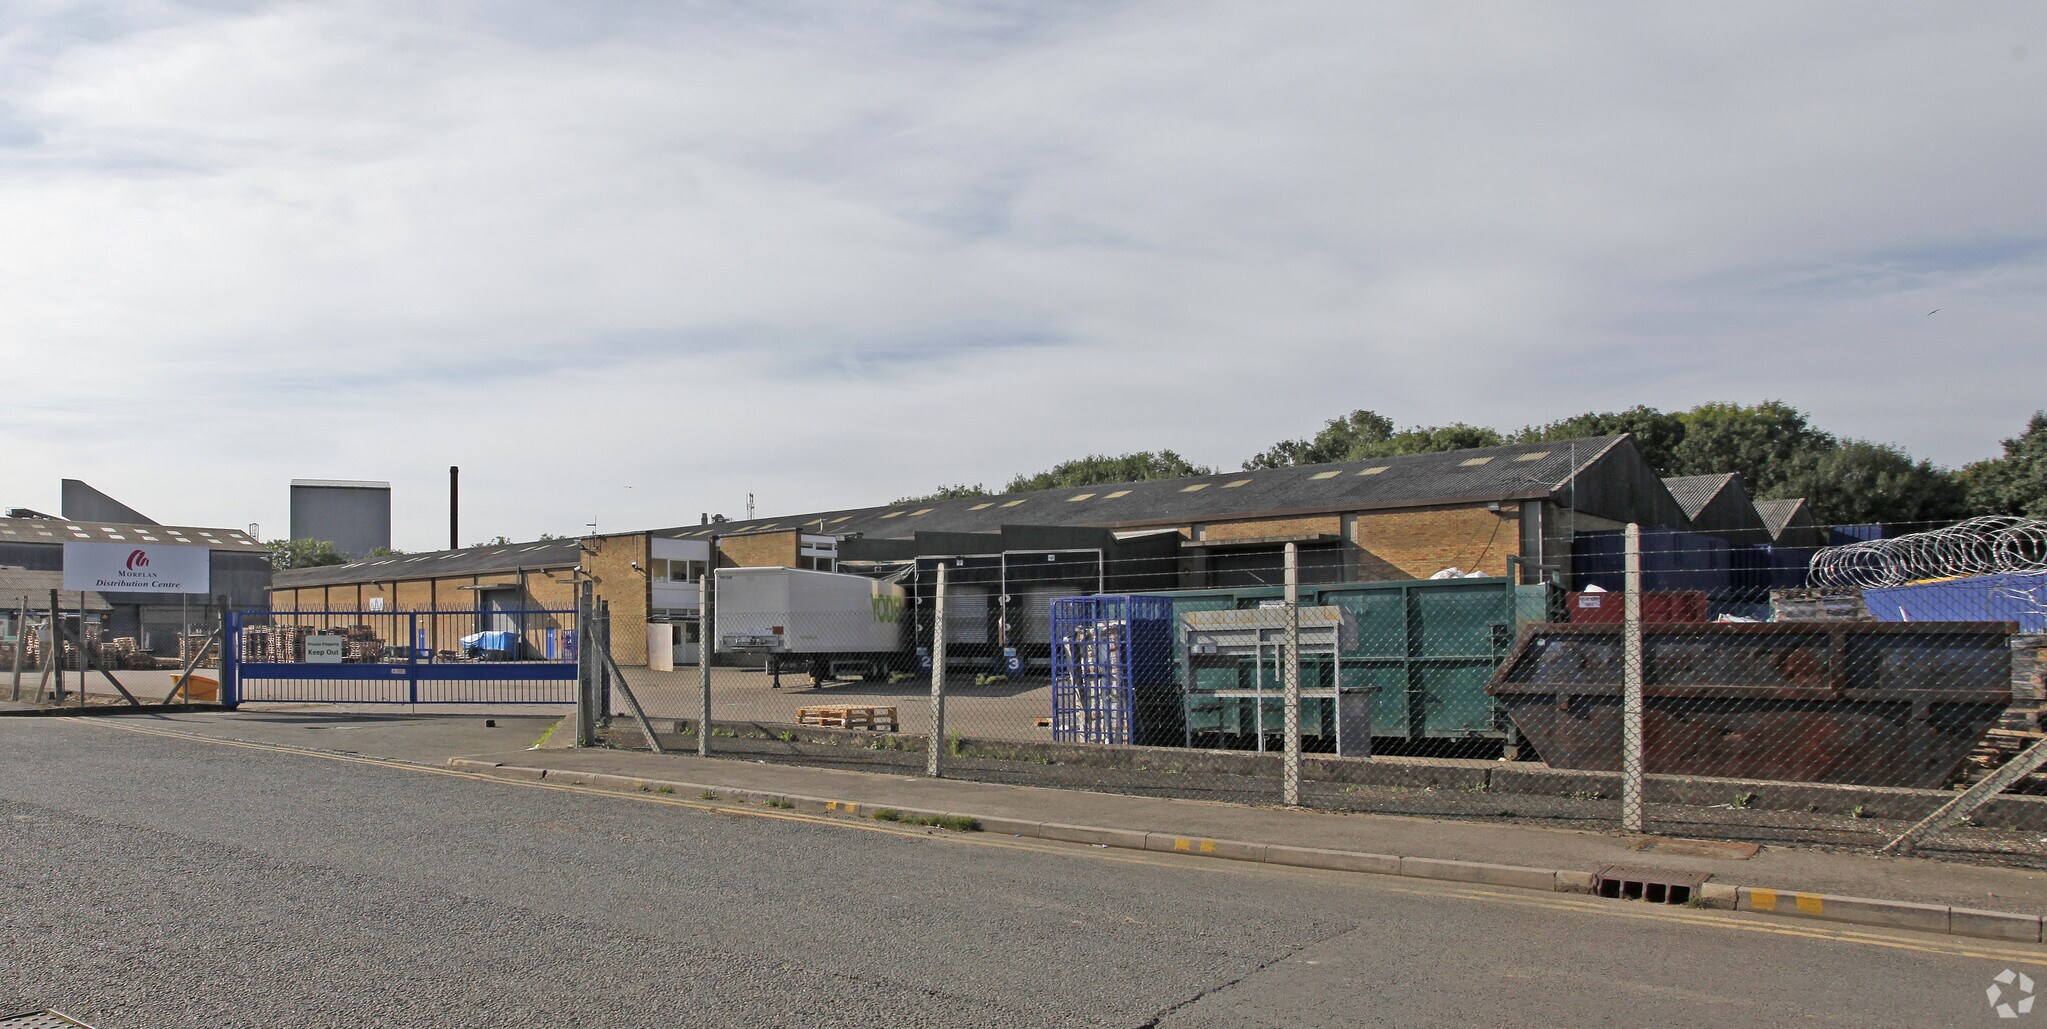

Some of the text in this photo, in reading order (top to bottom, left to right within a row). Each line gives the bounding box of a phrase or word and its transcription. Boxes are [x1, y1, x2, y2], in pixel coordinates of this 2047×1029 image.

[96, 579, 181, 588] Distribution Centre
[921, 656, 932, 667] 2
[1008, 658, 1020, 669] 3
